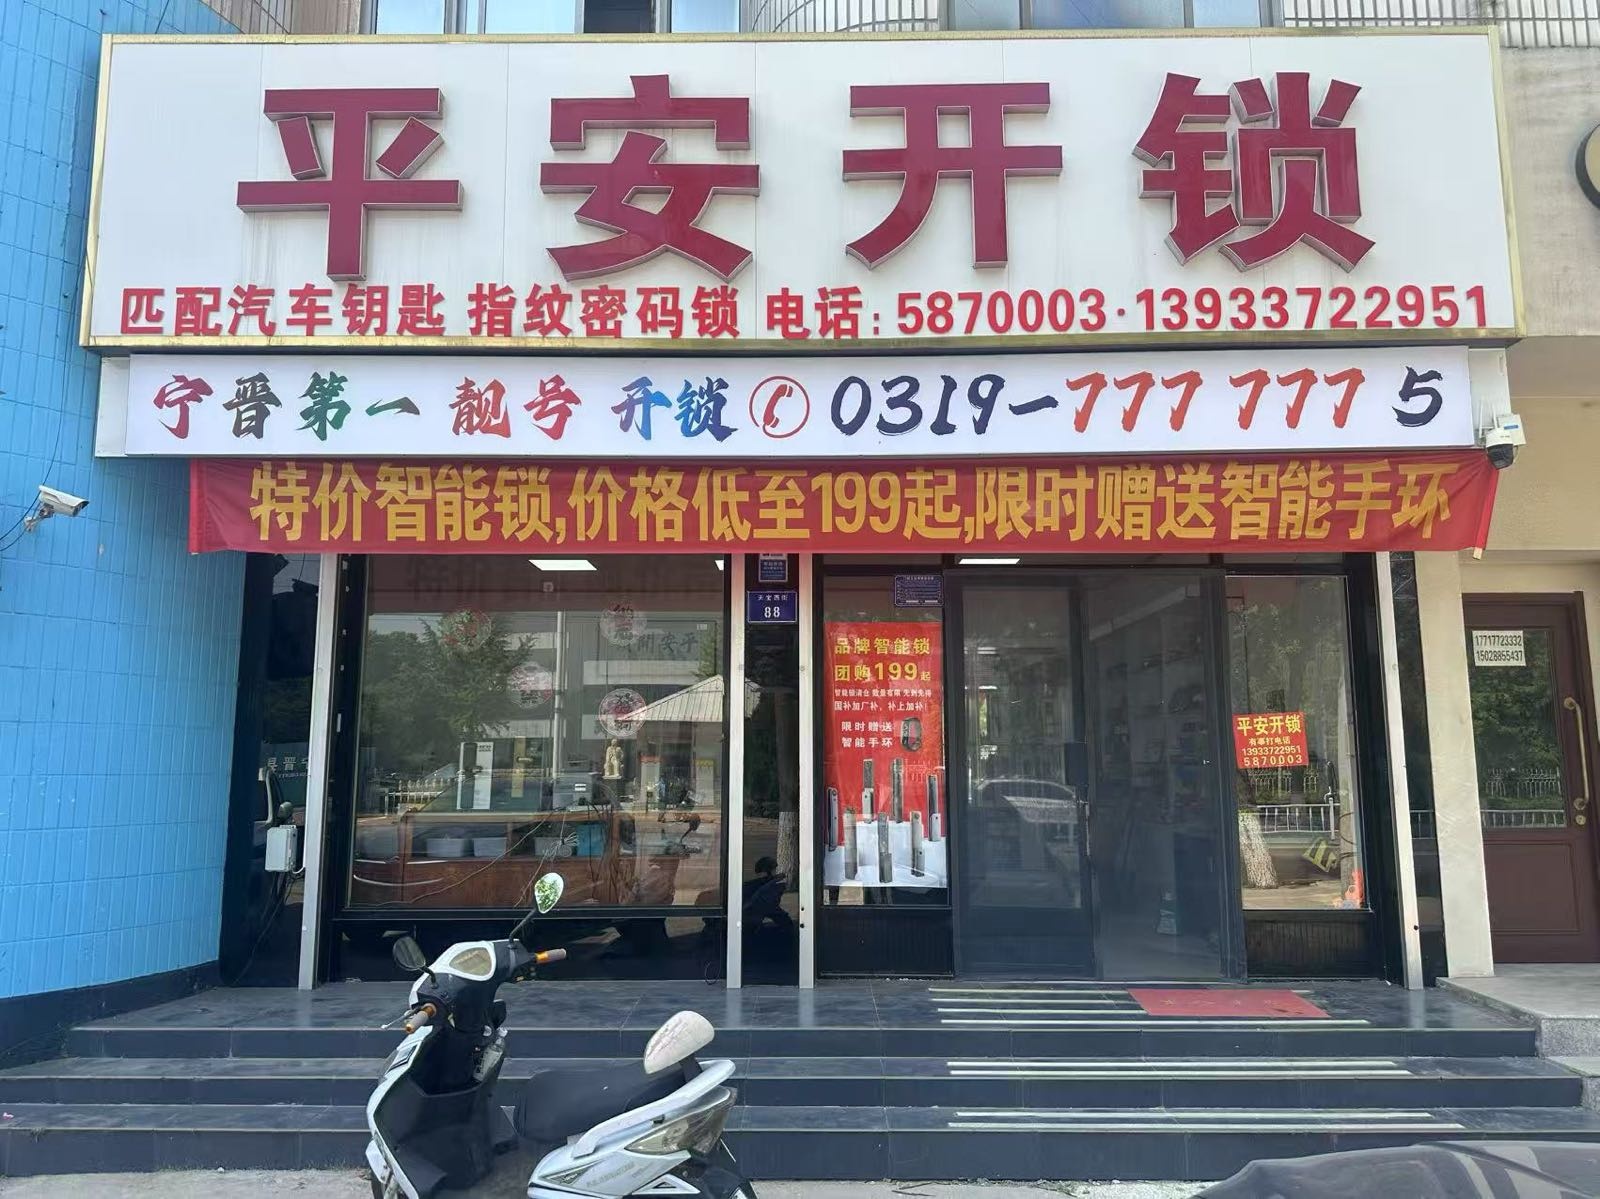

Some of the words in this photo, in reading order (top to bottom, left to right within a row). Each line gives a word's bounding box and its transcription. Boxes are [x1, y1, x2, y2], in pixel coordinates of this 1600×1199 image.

[235, 72, 1375, 282] 平安开锁
[120, 282, 446, 337] 匹配汽车钥匙
[467, 282, 741, 338] 指纹密码锁
[152, 371, 421, 441] 宁晋第一
[448, 373, 581, 440] 靓号
[610, 375, 740, 442] 开锁
[1391, 365, 1444, 428] 5
[764, 606, 781, 618] 88
[835, 637, 930, 655] 品牌智能锁
[834, 661, 931, 681] 团购199起
[841, 721, 893, 732] 限时赠送
[1237, 714, 1301, 736] 平安开锁
[841, 737, 893, 748] 智能手环
[1241, 745, 1301, 757] 13933722951
[1243, 754, 1303, 767] 5870003
